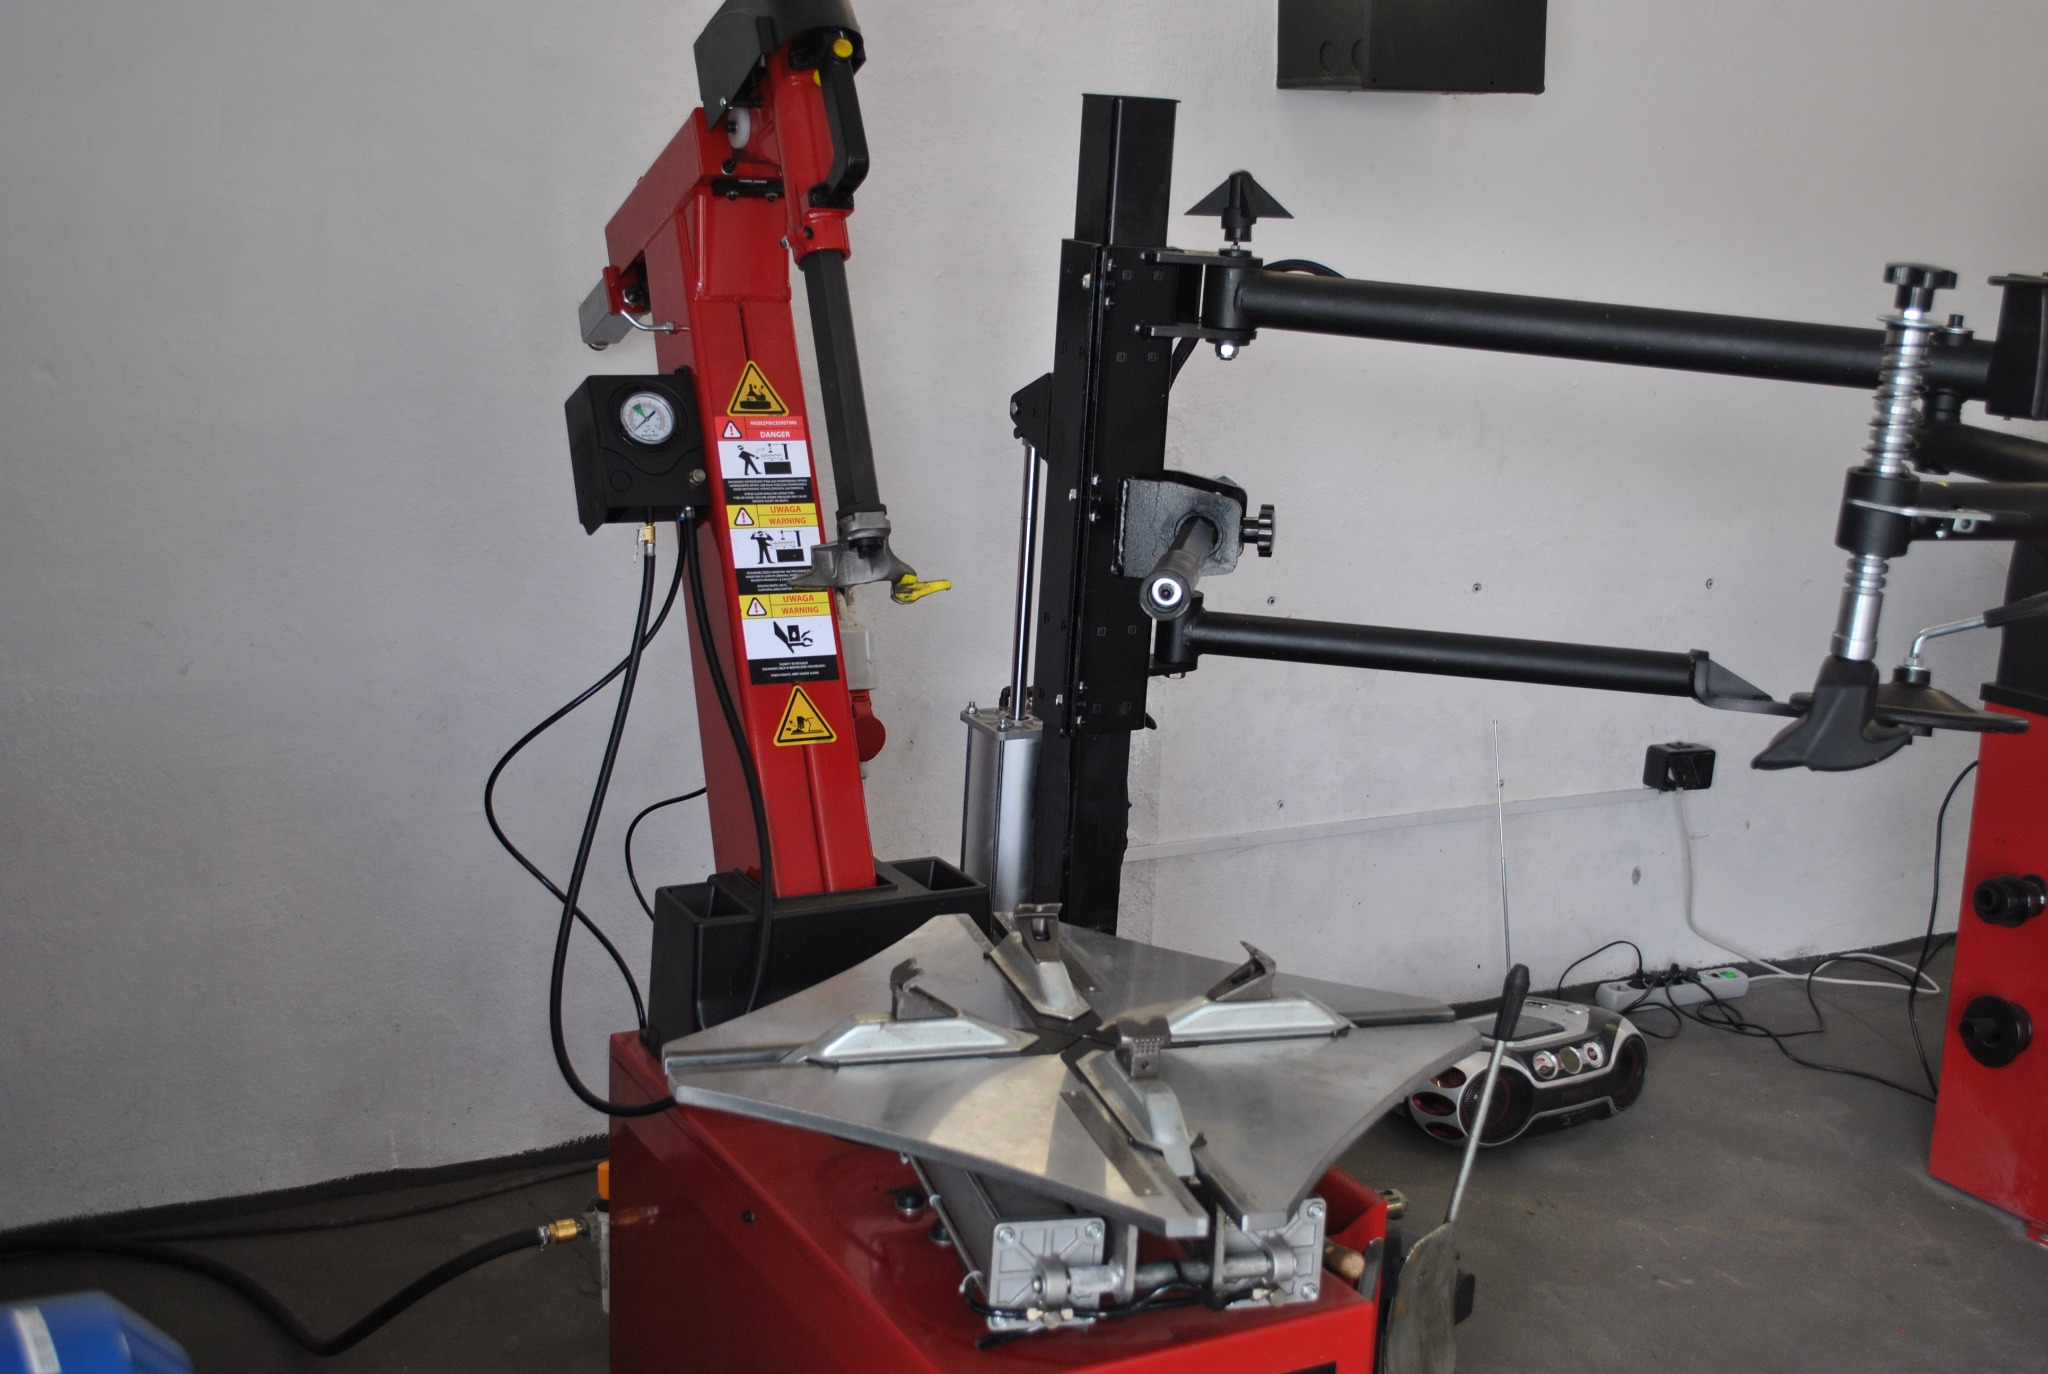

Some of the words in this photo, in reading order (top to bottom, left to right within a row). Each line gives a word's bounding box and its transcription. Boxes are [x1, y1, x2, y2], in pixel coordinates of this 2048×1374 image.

[770, 505, 802, 513] UWAGA
[768, 517, 807, 525] WARNING
[782, 594, 815, 603] UWAGA
[781, 606, 819, 615] WARNING
